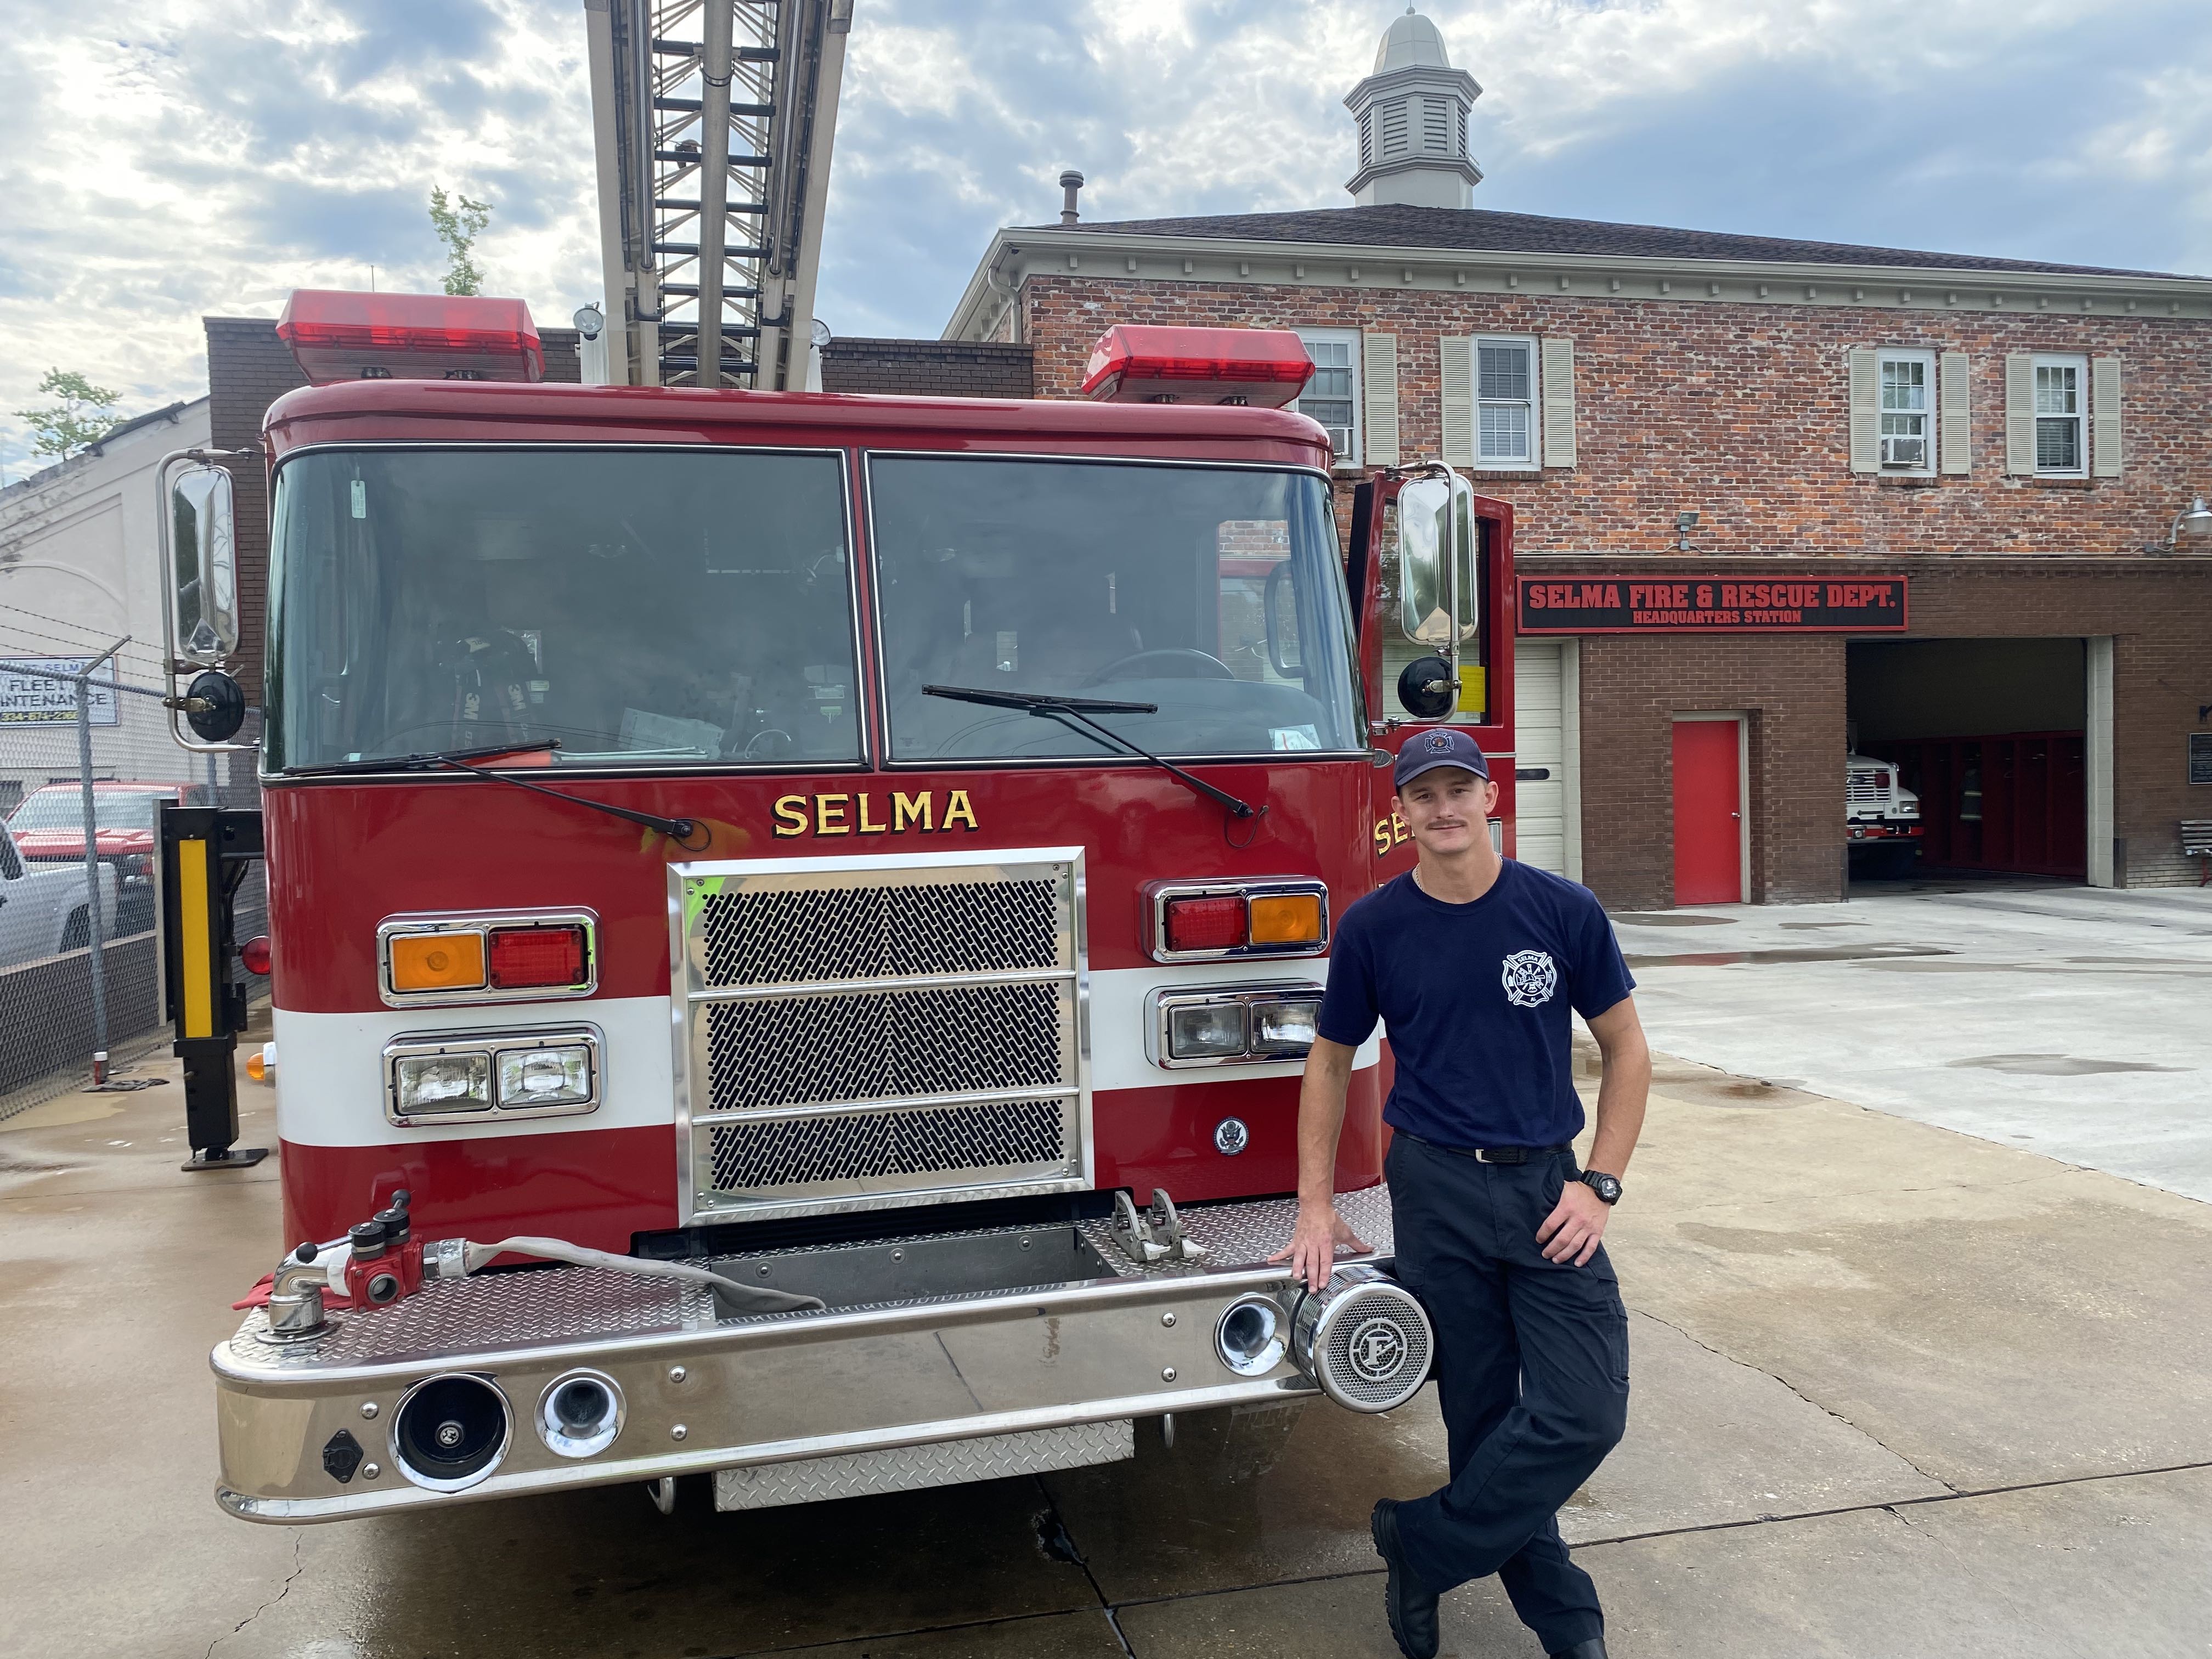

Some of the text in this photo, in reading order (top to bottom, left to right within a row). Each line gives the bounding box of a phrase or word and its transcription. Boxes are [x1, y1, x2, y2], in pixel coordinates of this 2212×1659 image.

[1528, 584, 1896, 608] SELMA FIRE & RESCUE DEPT.
[1633, 610, 1802, 625] HEADQUARTERS STATION
[463, 692, 480, 720] 3M
[772, 790, 979, 837] SELMA
[1374, 812, 1416, 856] SE
